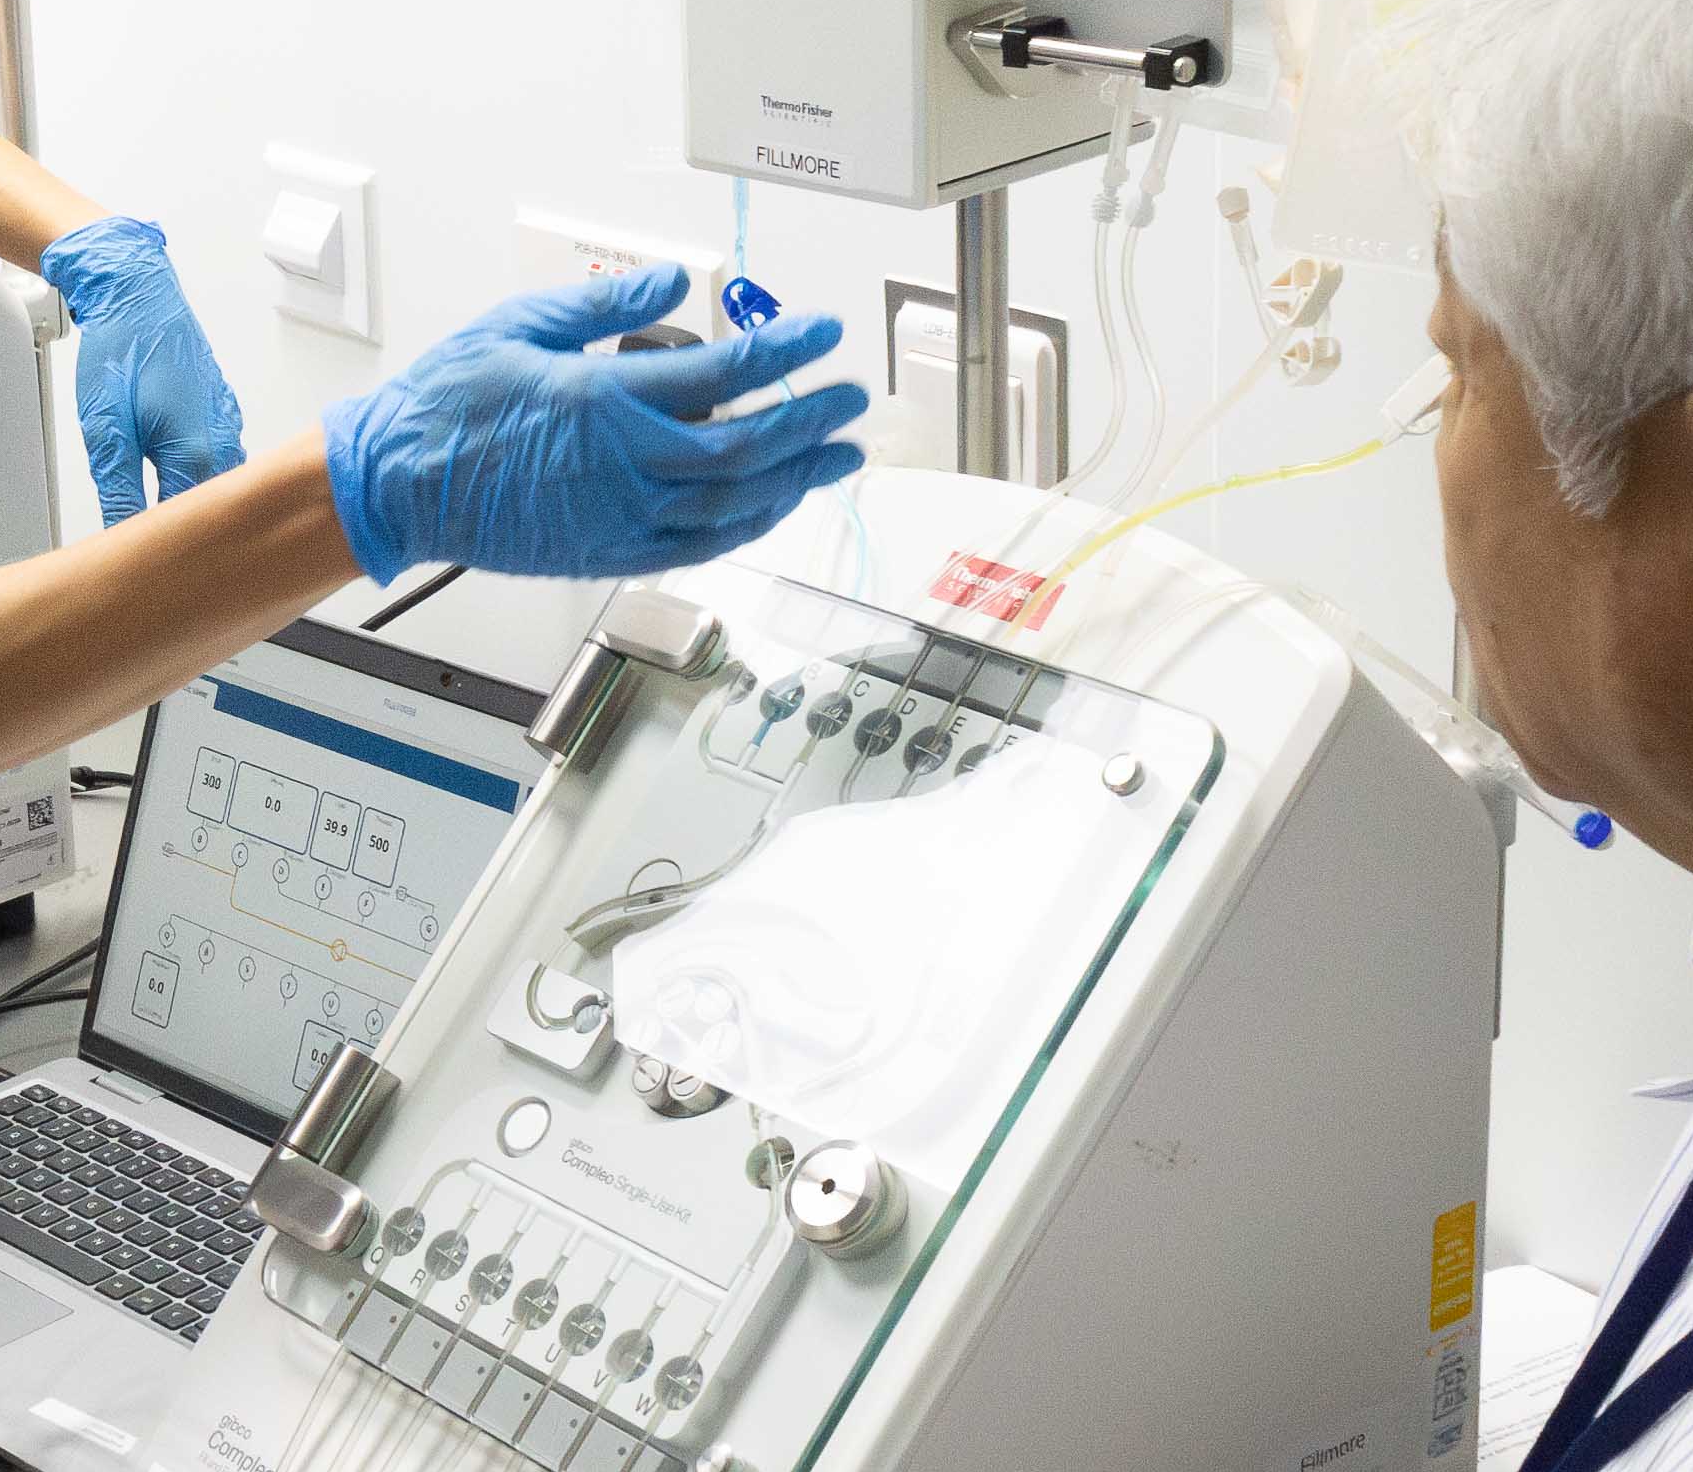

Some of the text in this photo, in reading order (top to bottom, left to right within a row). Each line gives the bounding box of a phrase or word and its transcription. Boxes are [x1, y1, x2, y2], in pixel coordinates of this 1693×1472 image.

[756, 145, 841, 180] FILLMORE
[853, 679, 871, 698] C
[899, 696, 918, 715] D
[948, 715, 968, 736] E
[324, 817, 349, 838] 39.9
[369, 834, 391, 854] 500
[561, 1148, 614, 1185] Compleo
[410, 1267, 427, 1289] R
[455, 1293, 471, 1312] S
[501, 1317, 516, 1337] T
[545, 1342, 563, 1363] U
[592, 1368, 609, 1389] V
[634, 1392, 657, 1417] W
[218, 1414, 252, 1440] gibco
